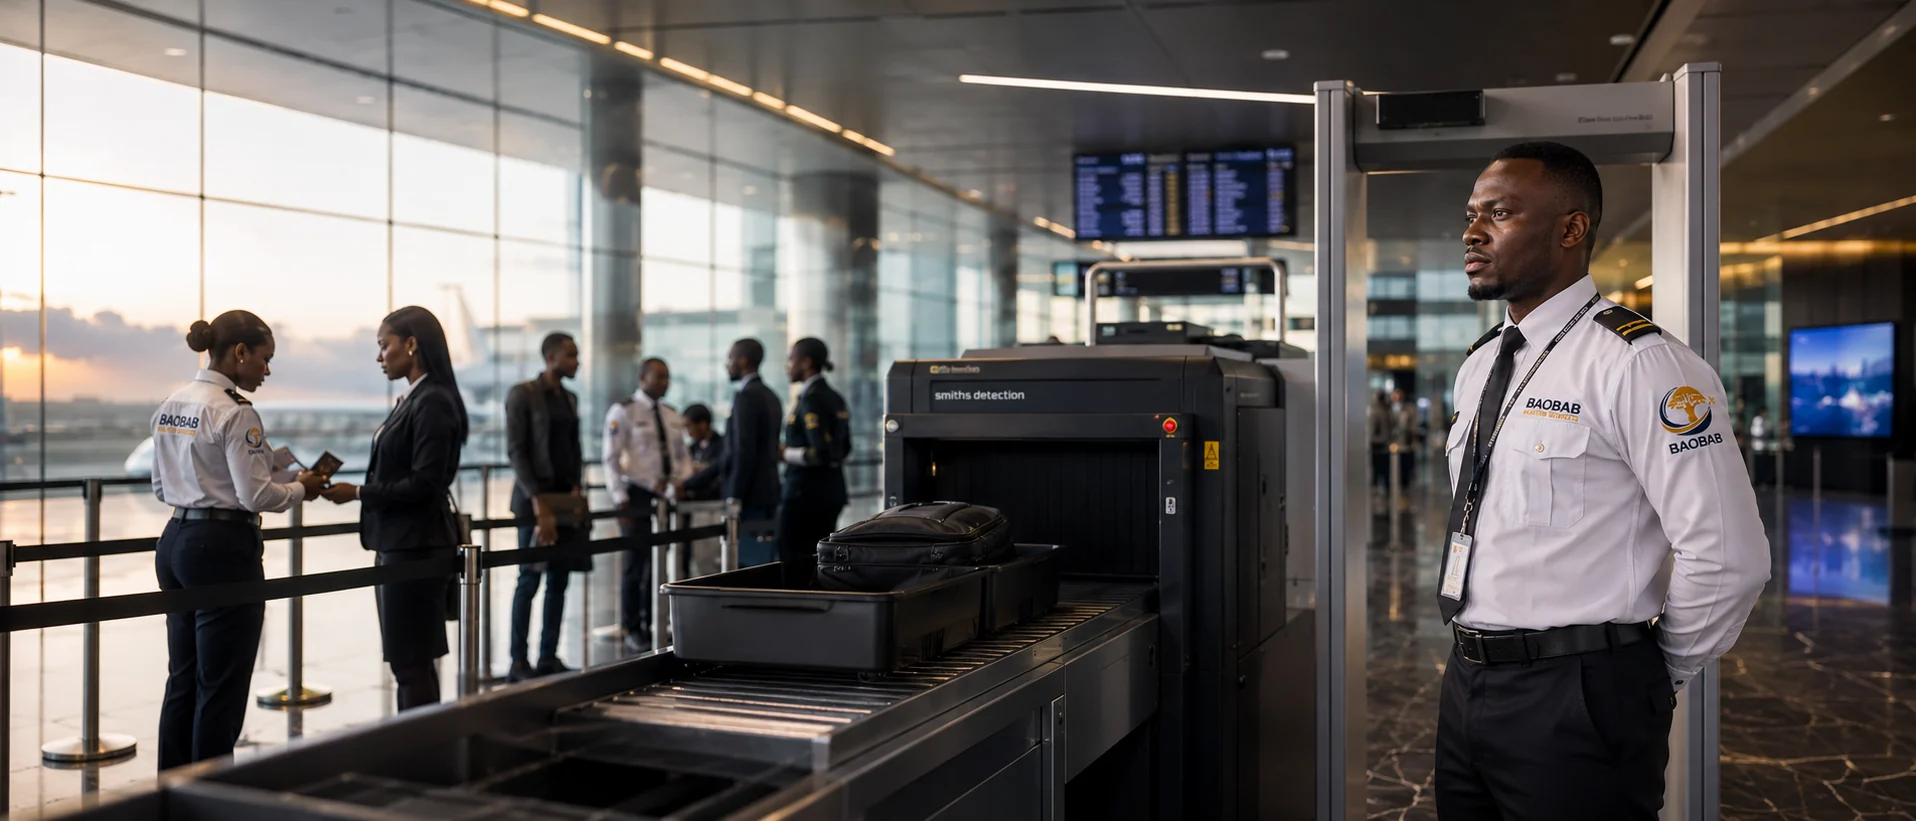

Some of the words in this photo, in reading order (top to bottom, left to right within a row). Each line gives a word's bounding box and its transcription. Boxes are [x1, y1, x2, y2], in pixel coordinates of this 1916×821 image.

[935, 390, 972, 400] smiths
[973, 390, 1025, 400] detection
[1526, 397, 1581, 415] BAOBAB
[159, 413, 200, 429] BAOBAB
[1668, 433, 1723, 455] BAOBAB
